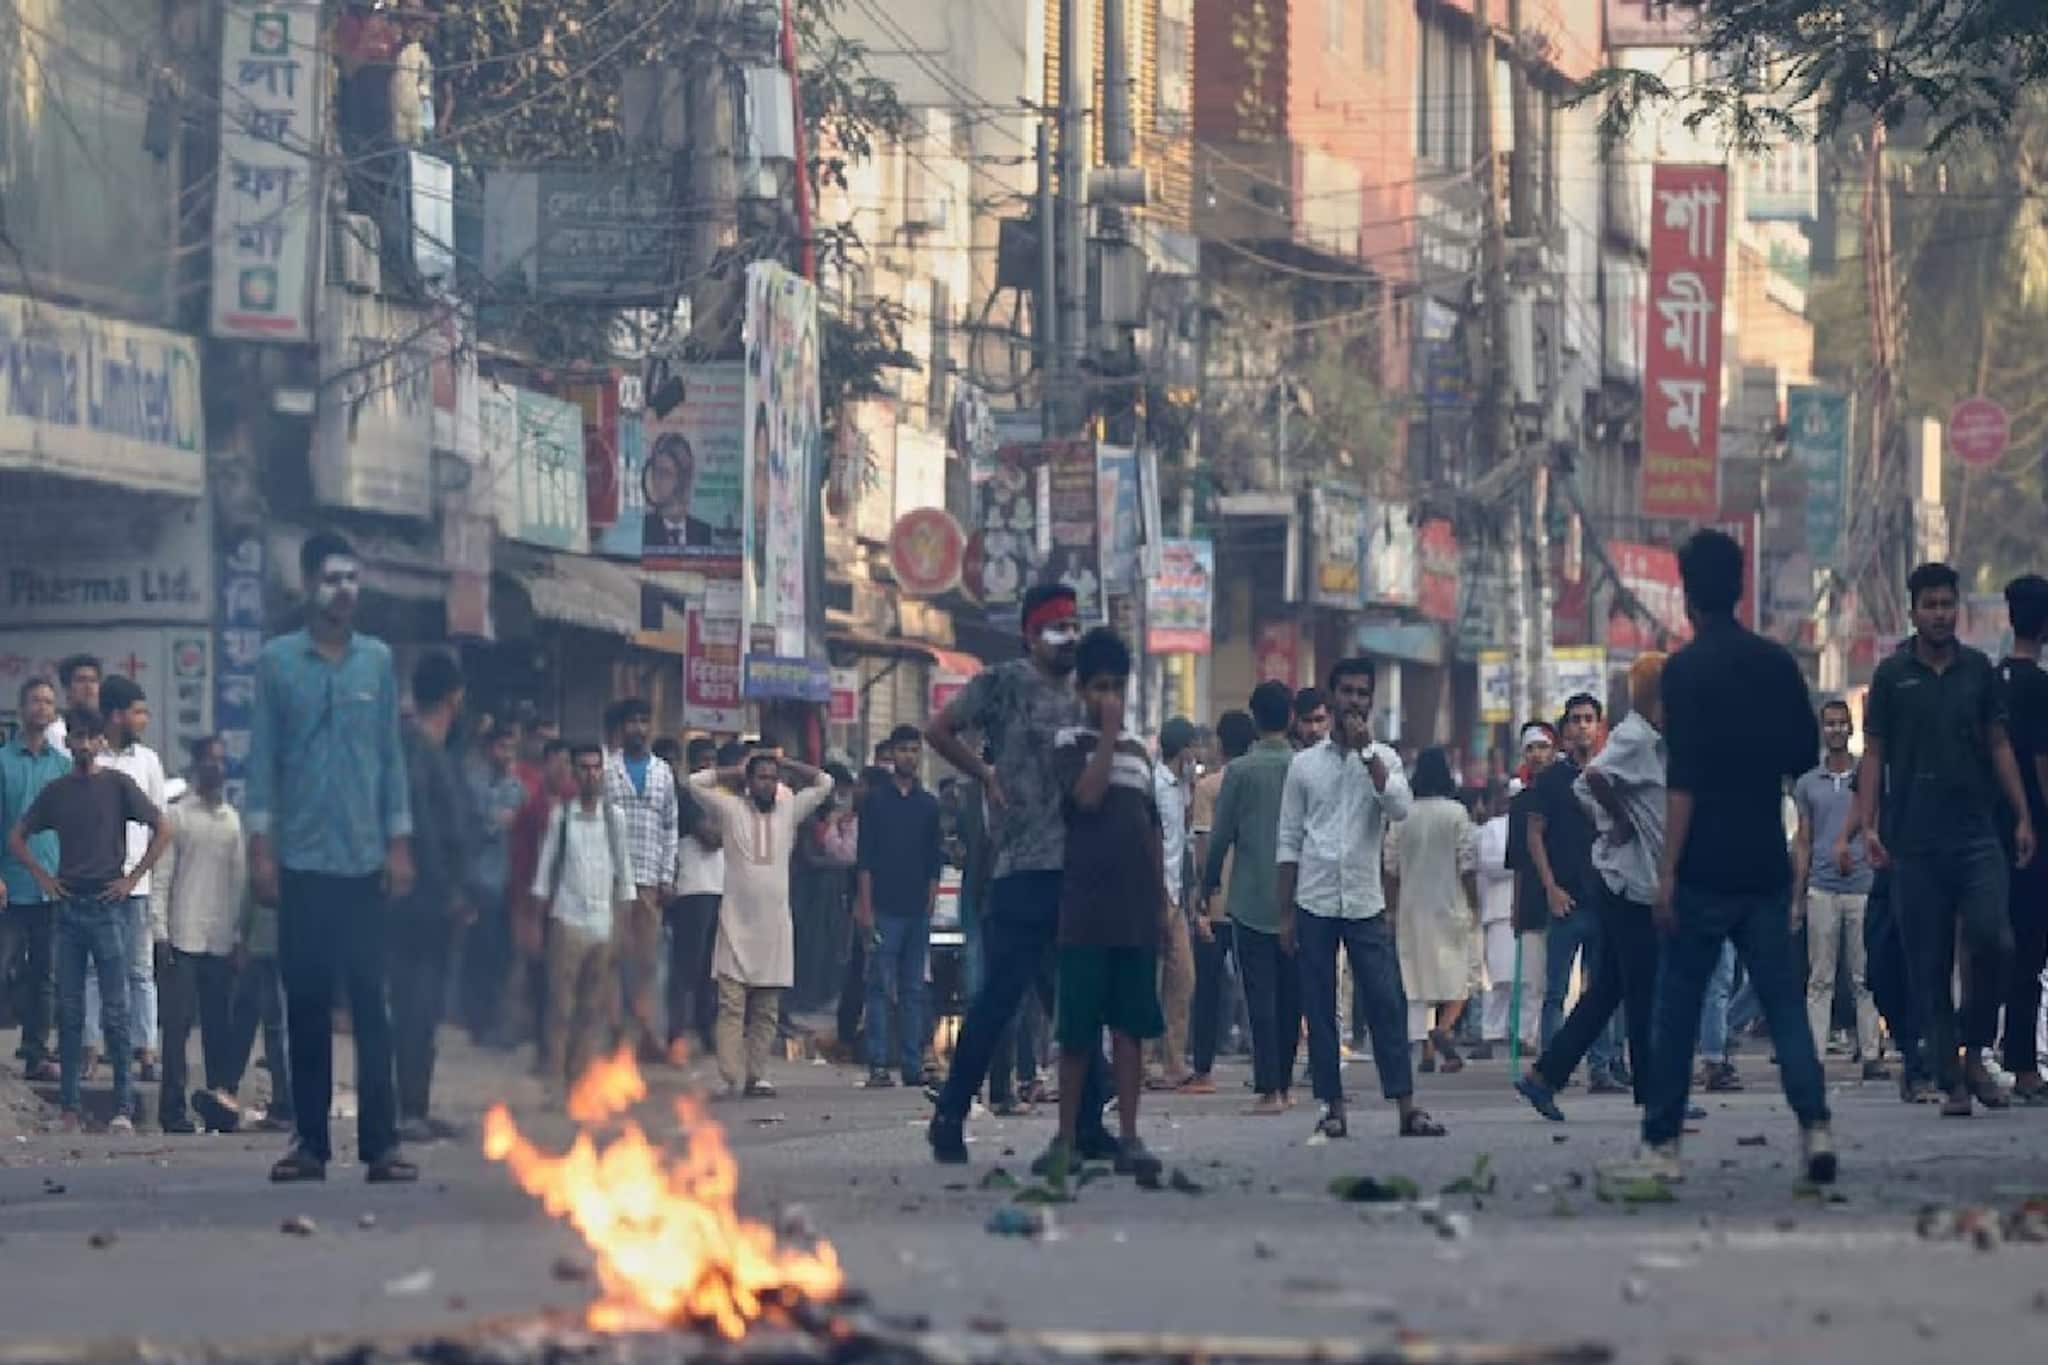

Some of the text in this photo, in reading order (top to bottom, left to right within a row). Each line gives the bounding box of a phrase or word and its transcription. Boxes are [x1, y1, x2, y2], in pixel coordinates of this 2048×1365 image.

[1655, 181, 1721, 447] শামীম
[9, 568, 200, 606] Pharma Ltd.
